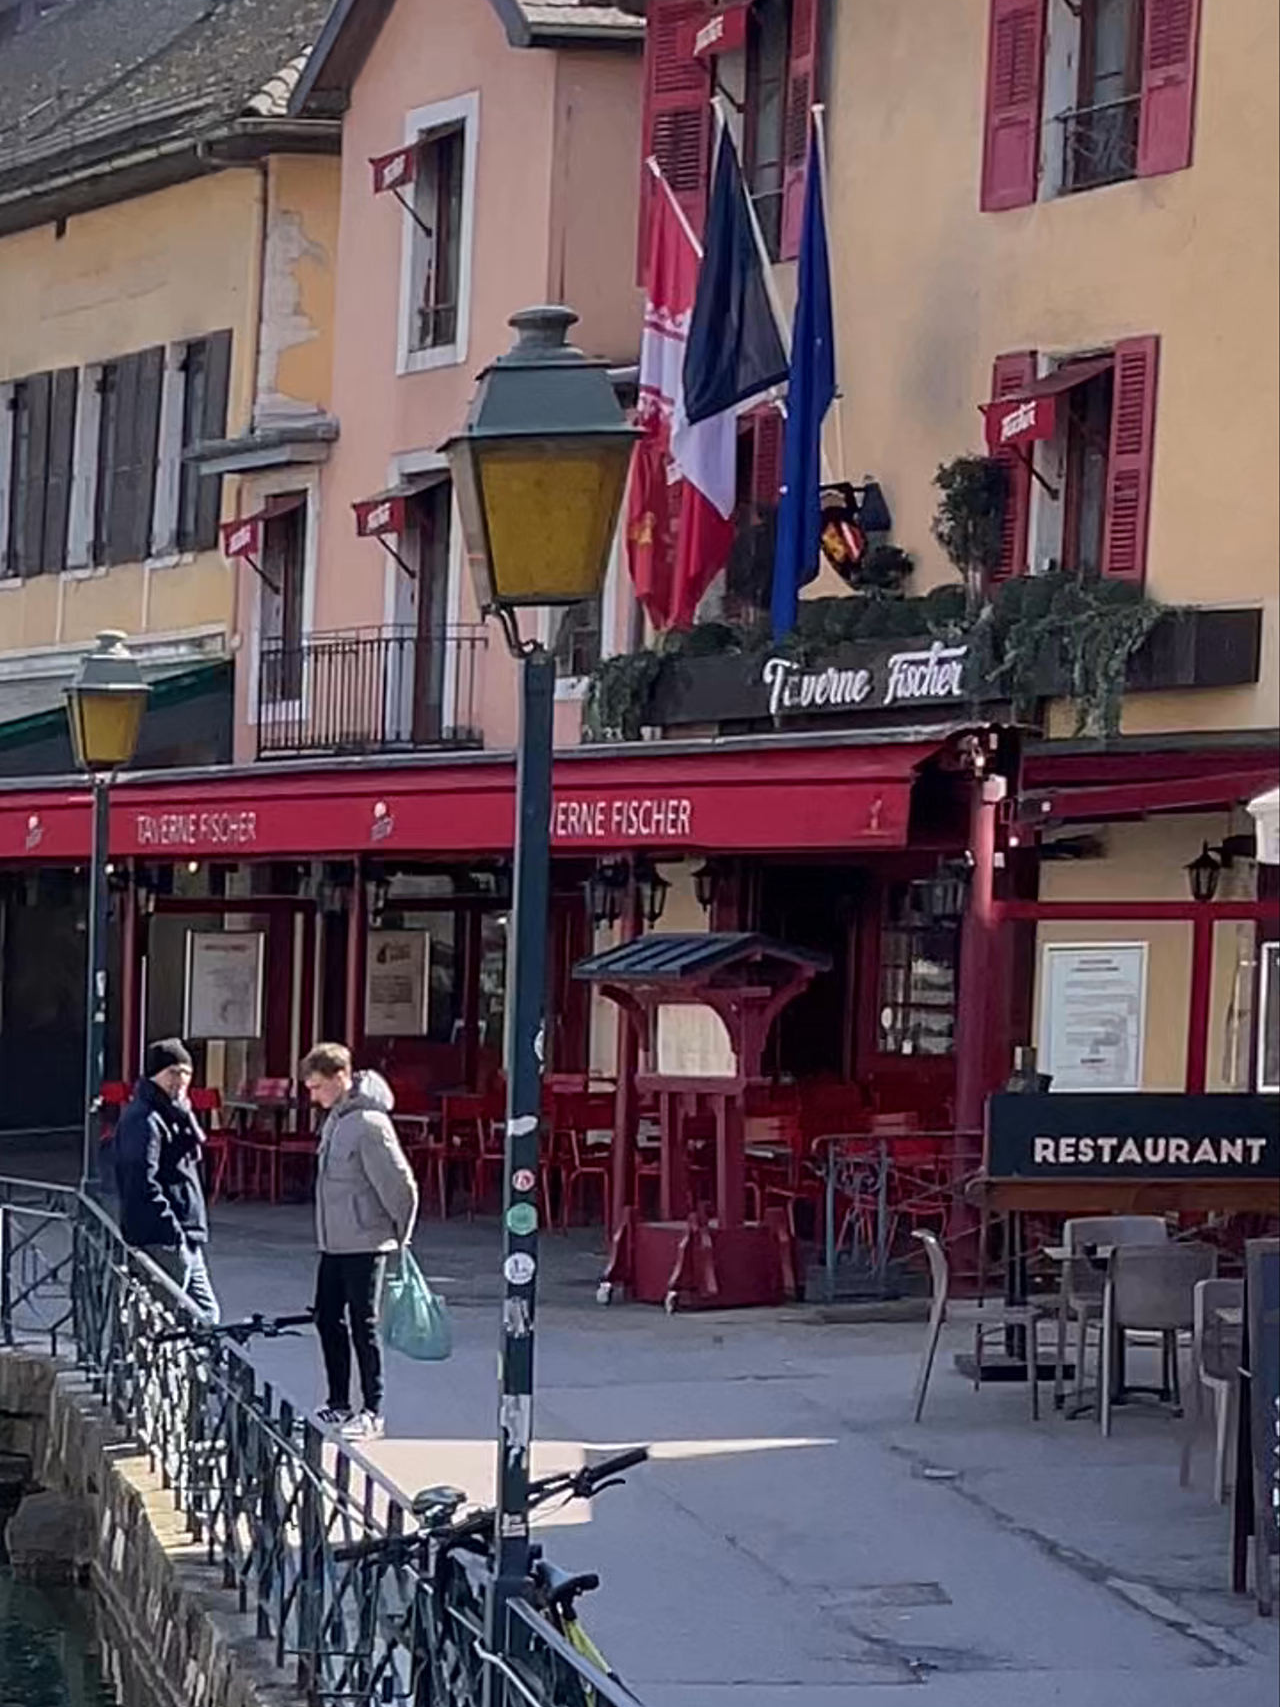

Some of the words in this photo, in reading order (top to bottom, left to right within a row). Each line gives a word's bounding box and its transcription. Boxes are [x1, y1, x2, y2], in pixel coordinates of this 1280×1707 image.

[884, 641, 968, 705] Fischer
[138, 814, 196, 843] TAVERNE
[201, 812, 256, 842] FISCHER
[611, 799, 691, 835] FISCHER
[1034, 1137, 1267, 1164] RESTAURANT
